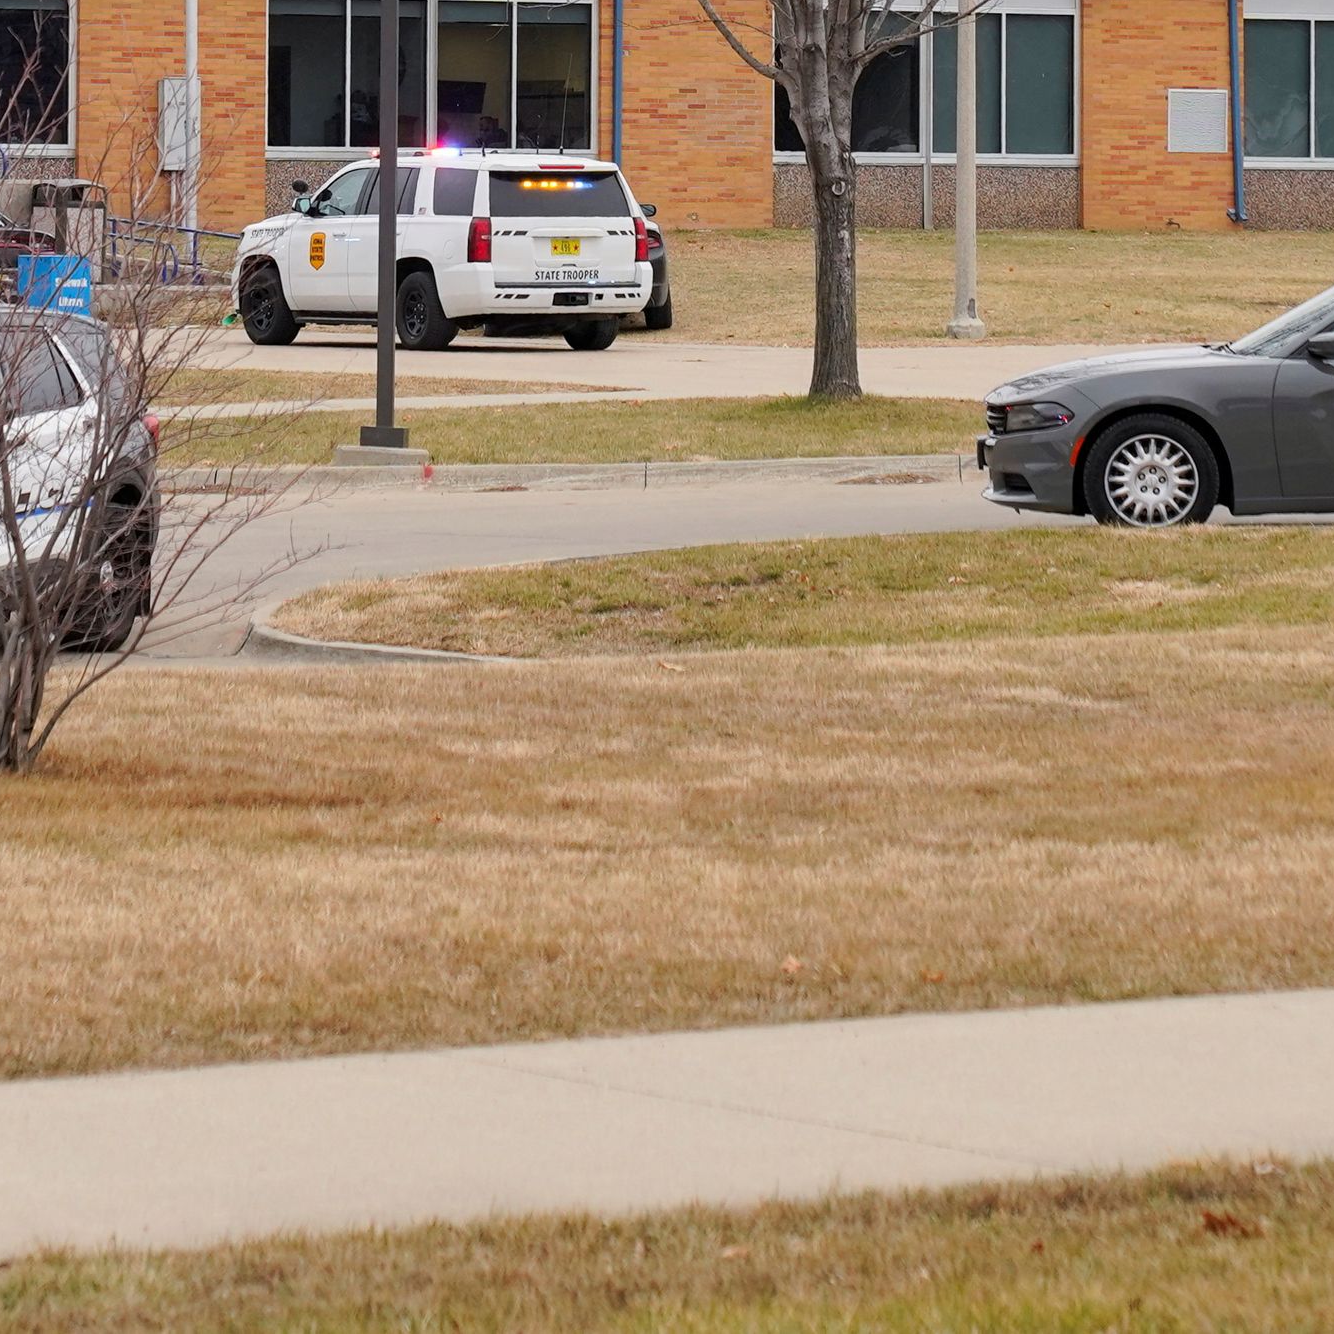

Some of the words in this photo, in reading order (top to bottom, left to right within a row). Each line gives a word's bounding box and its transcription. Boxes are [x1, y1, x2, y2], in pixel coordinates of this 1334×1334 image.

[535, 270, 560, 281] STATE
[562, 269, 599, 280] TROOPER
[58, 296, 84, 307] Library
